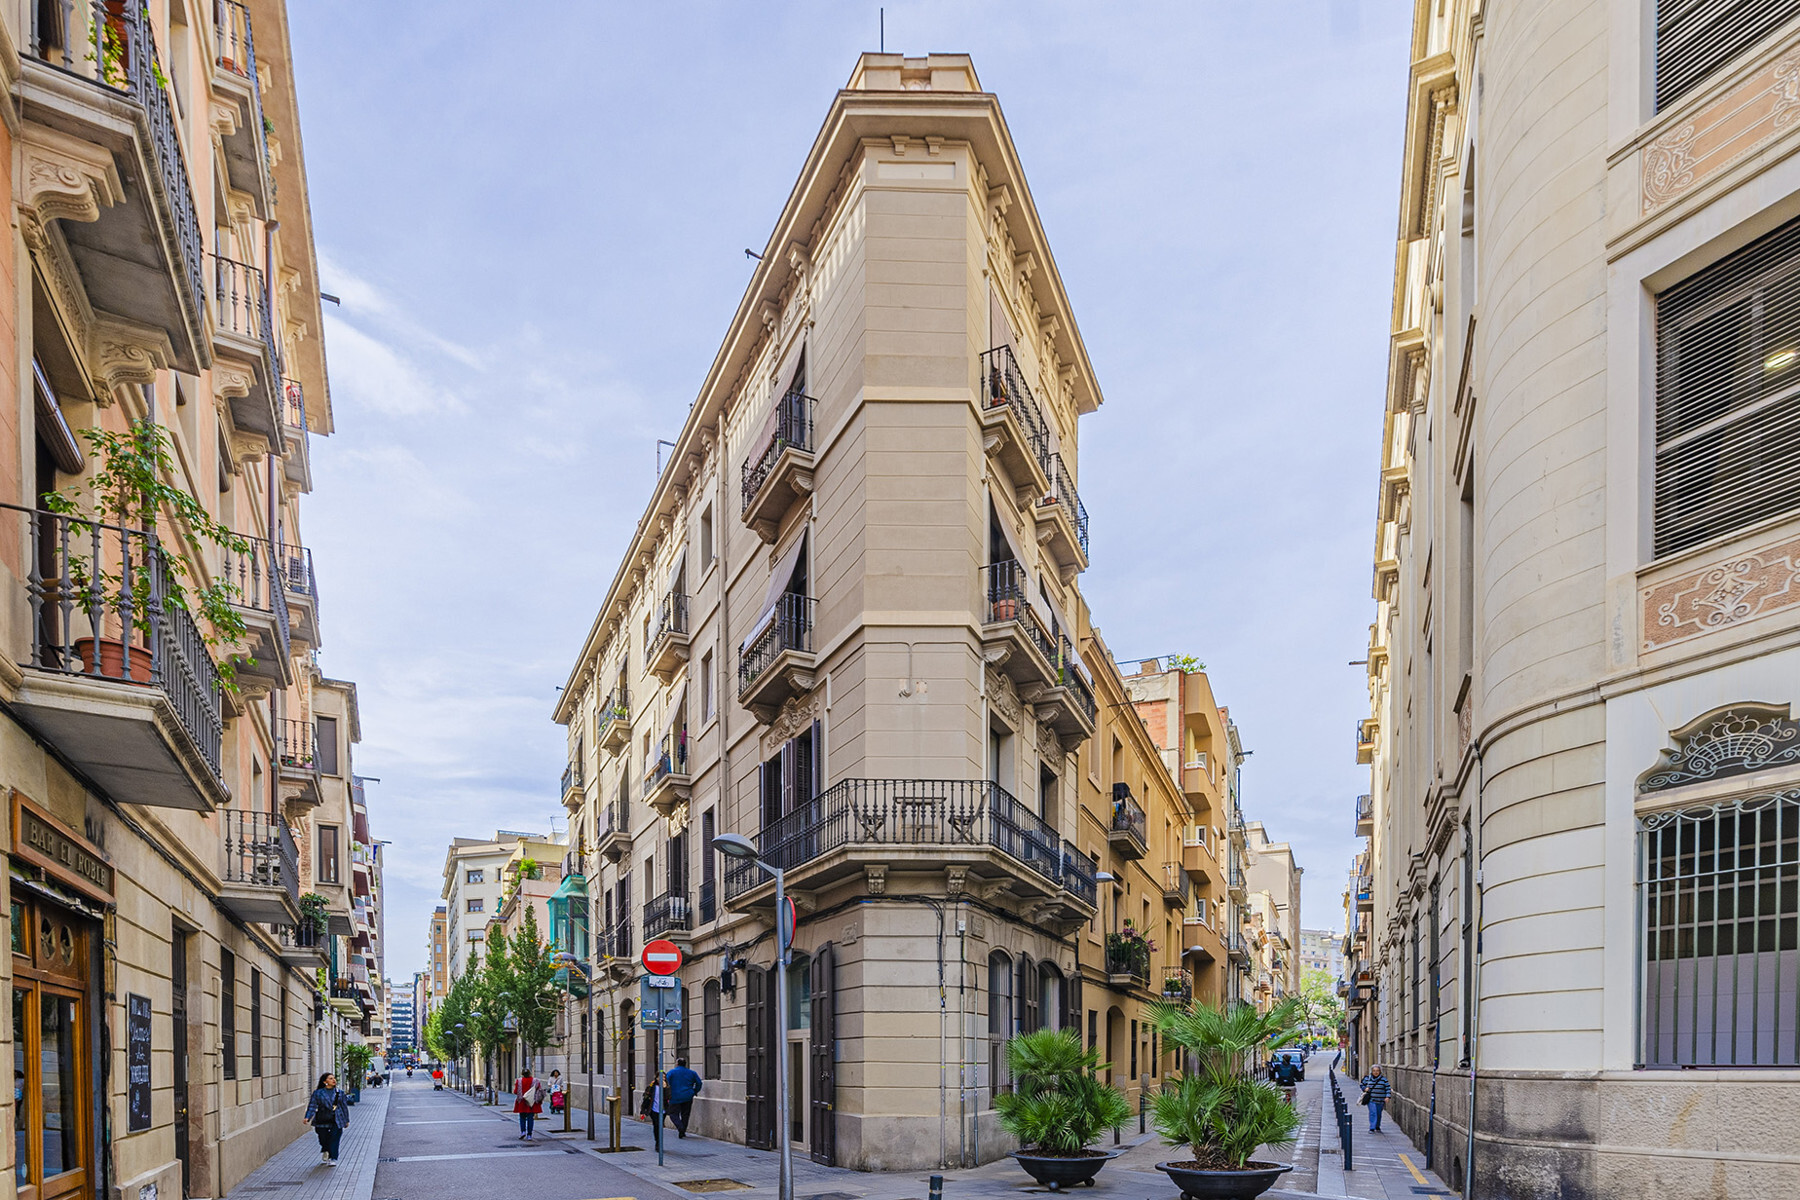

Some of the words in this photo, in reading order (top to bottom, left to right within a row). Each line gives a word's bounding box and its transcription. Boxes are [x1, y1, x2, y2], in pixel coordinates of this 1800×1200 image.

[30, 822, 53, 854] BAR
[61, 842, 72, 865] EL
[77, 854, 105, 885] ROBLE
